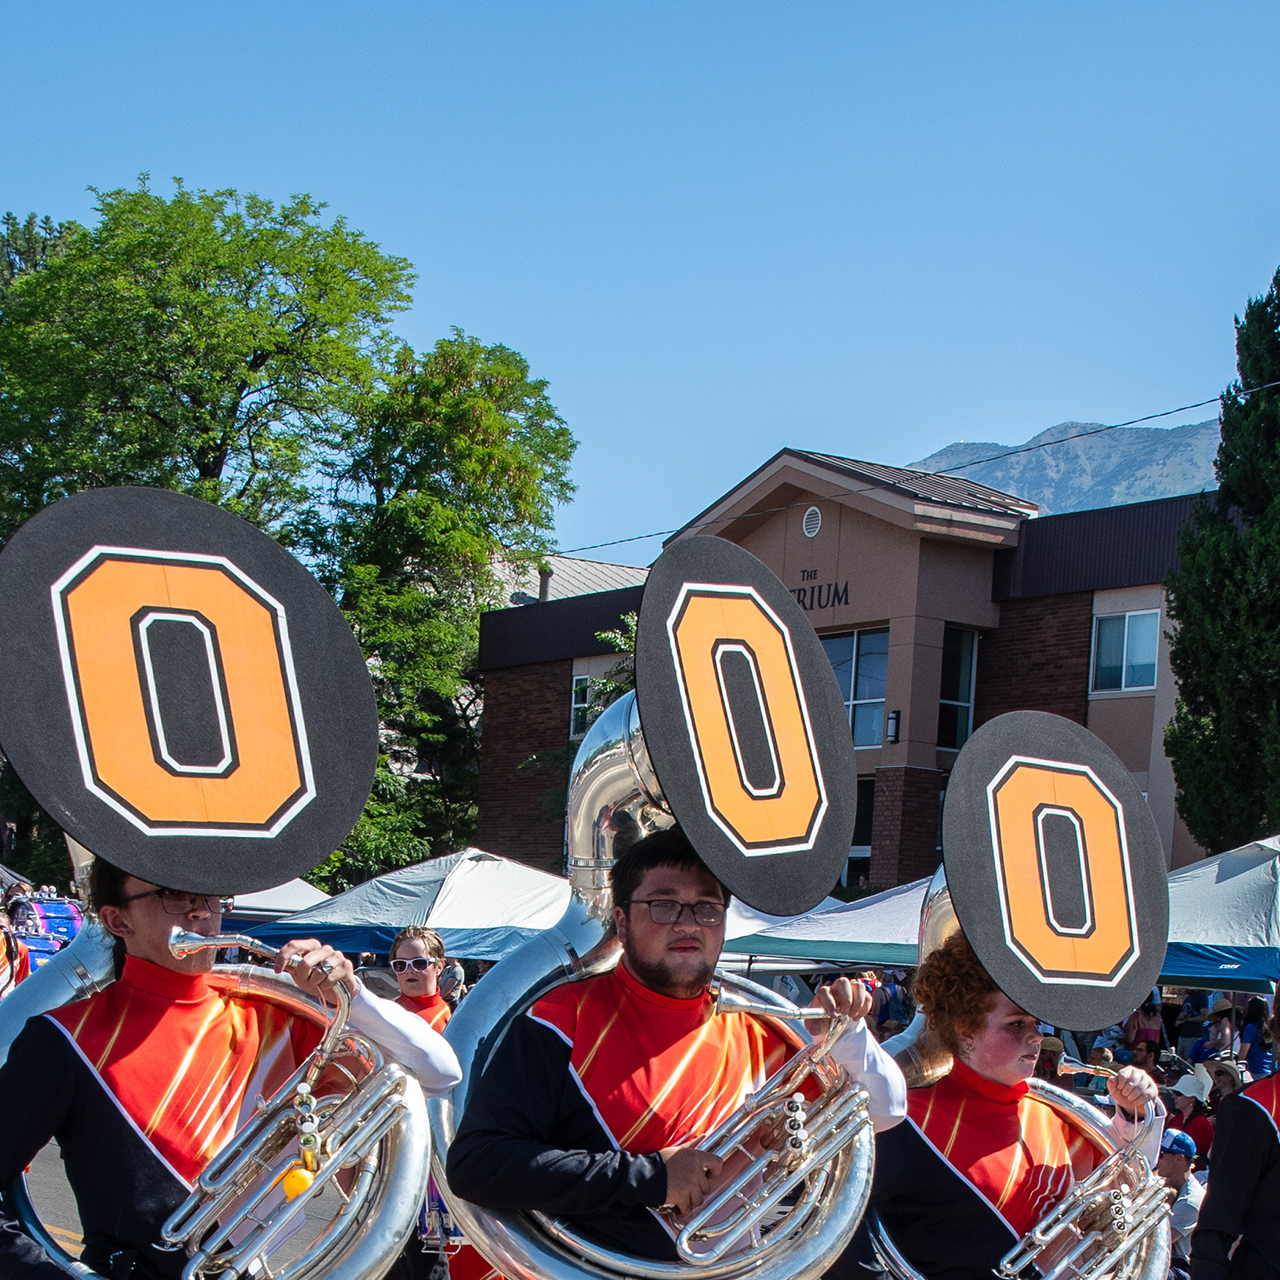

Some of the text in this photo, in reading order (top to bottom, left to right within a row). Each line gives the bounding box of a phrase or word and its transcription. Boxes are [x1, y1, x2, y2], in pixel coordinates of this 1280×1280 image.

[51, 545, 316, 838] O
[801, 568, 818, 582] THE
[666, 582, 828, 857] O
[986, 755, 1140, 987] O
